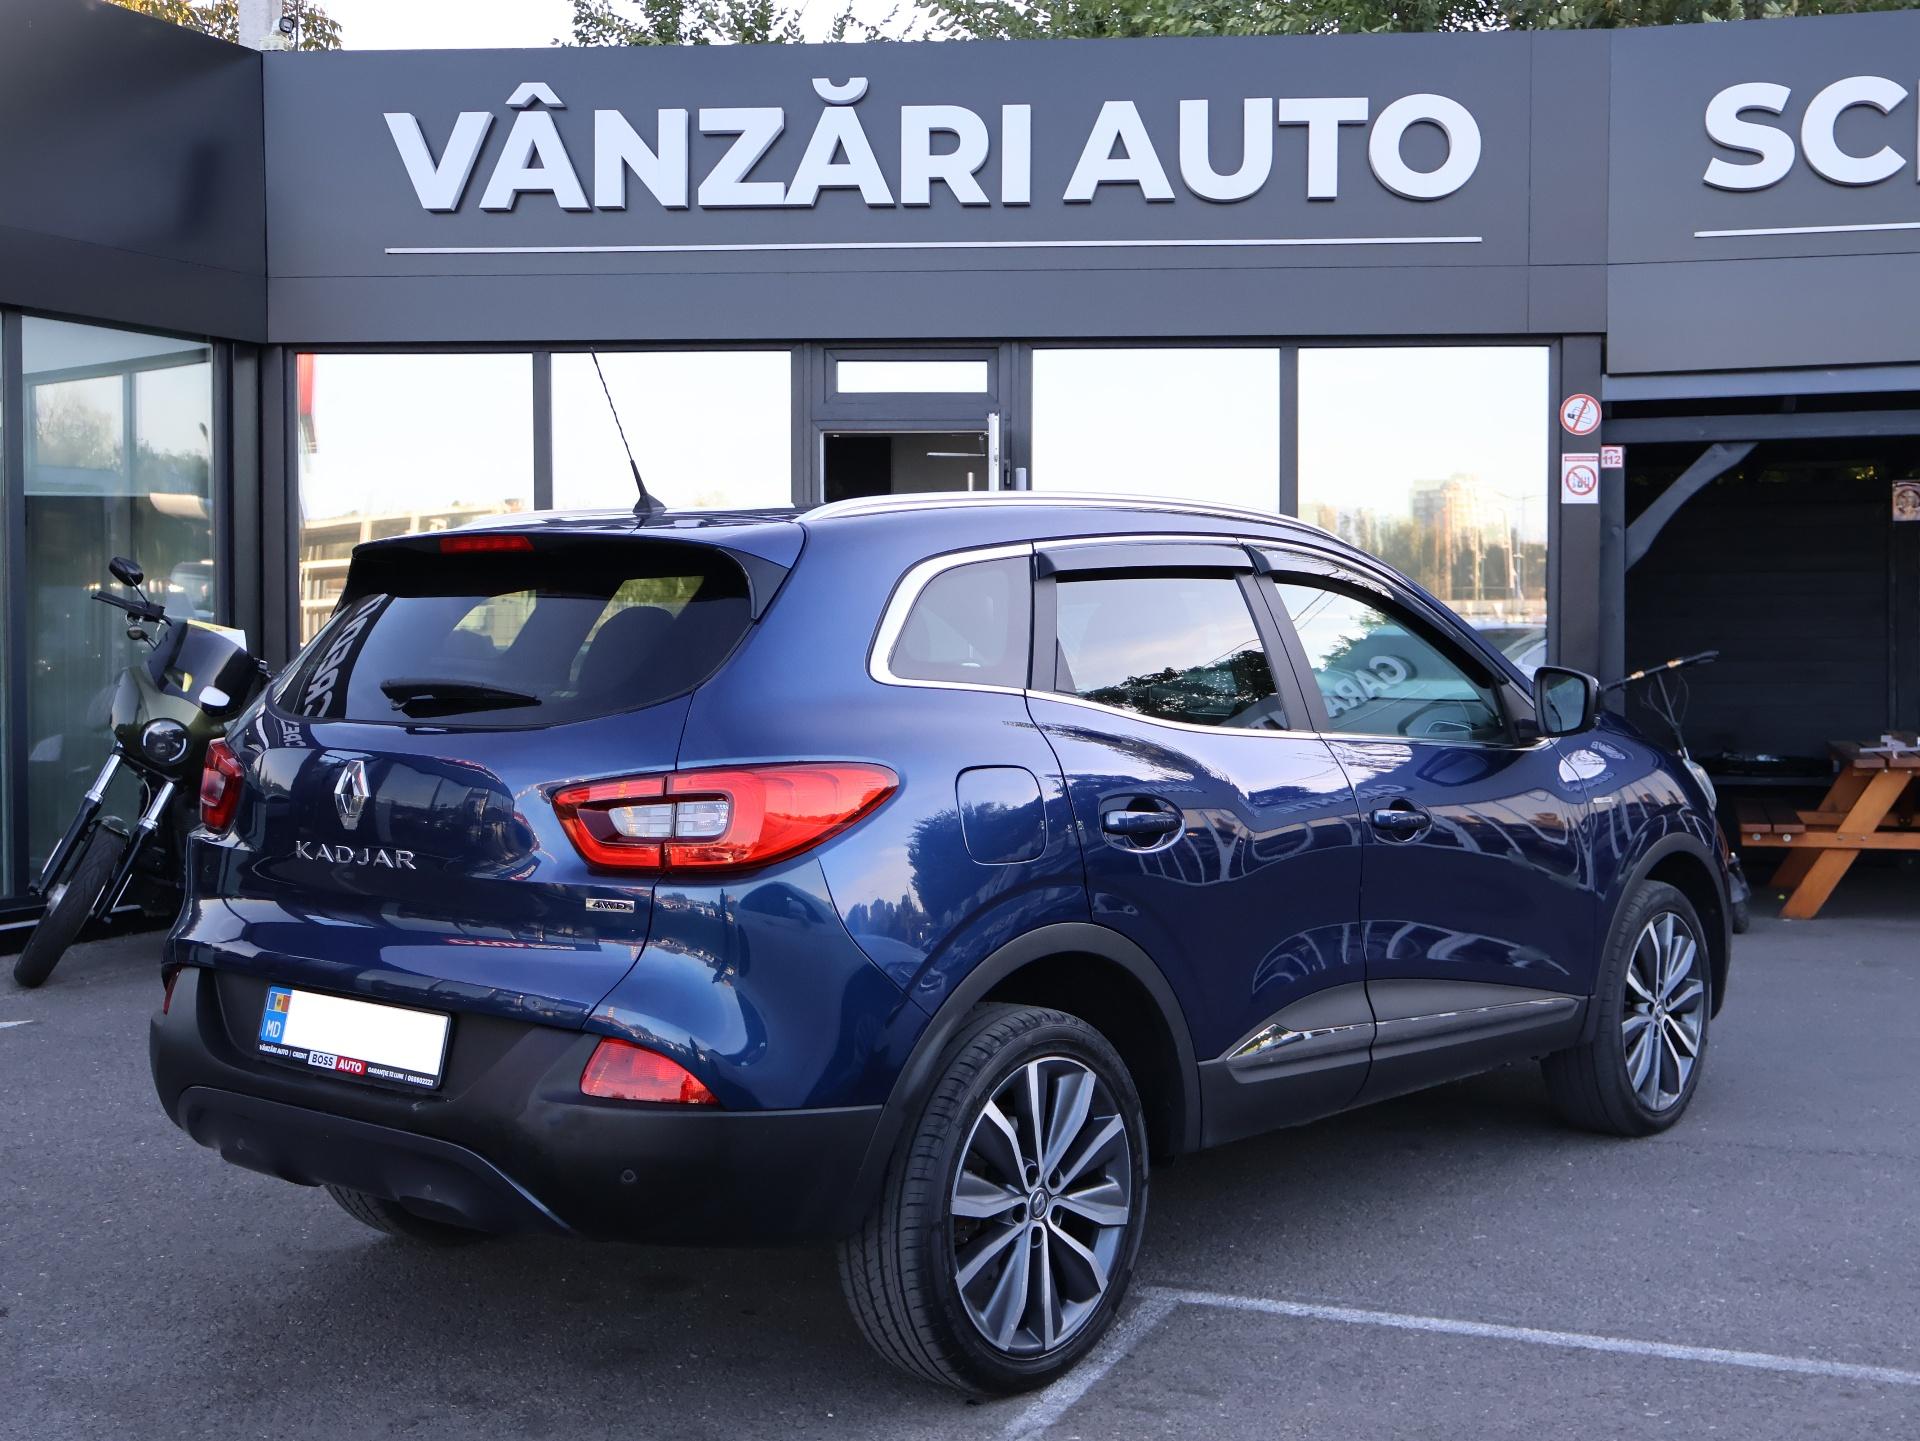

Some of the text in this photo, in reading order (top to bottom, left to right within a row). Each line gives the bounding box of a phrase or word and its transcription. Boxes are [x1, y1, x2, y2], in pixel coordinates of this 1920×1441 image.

[1703, 75, 1920, 191] SC
[383, 77, 1482, 211] VÂNZĂRI AUTO
[1602, 455, 1621, 465] 112
[295, 840, 417, 869] KADJAR
[592, 901, 625, 910] 4WD
[265, 1020, 281, 1037] MD
[311, 1053, 334, 1066] BOSS
[337, 1058, 362, 1072] AUTO
